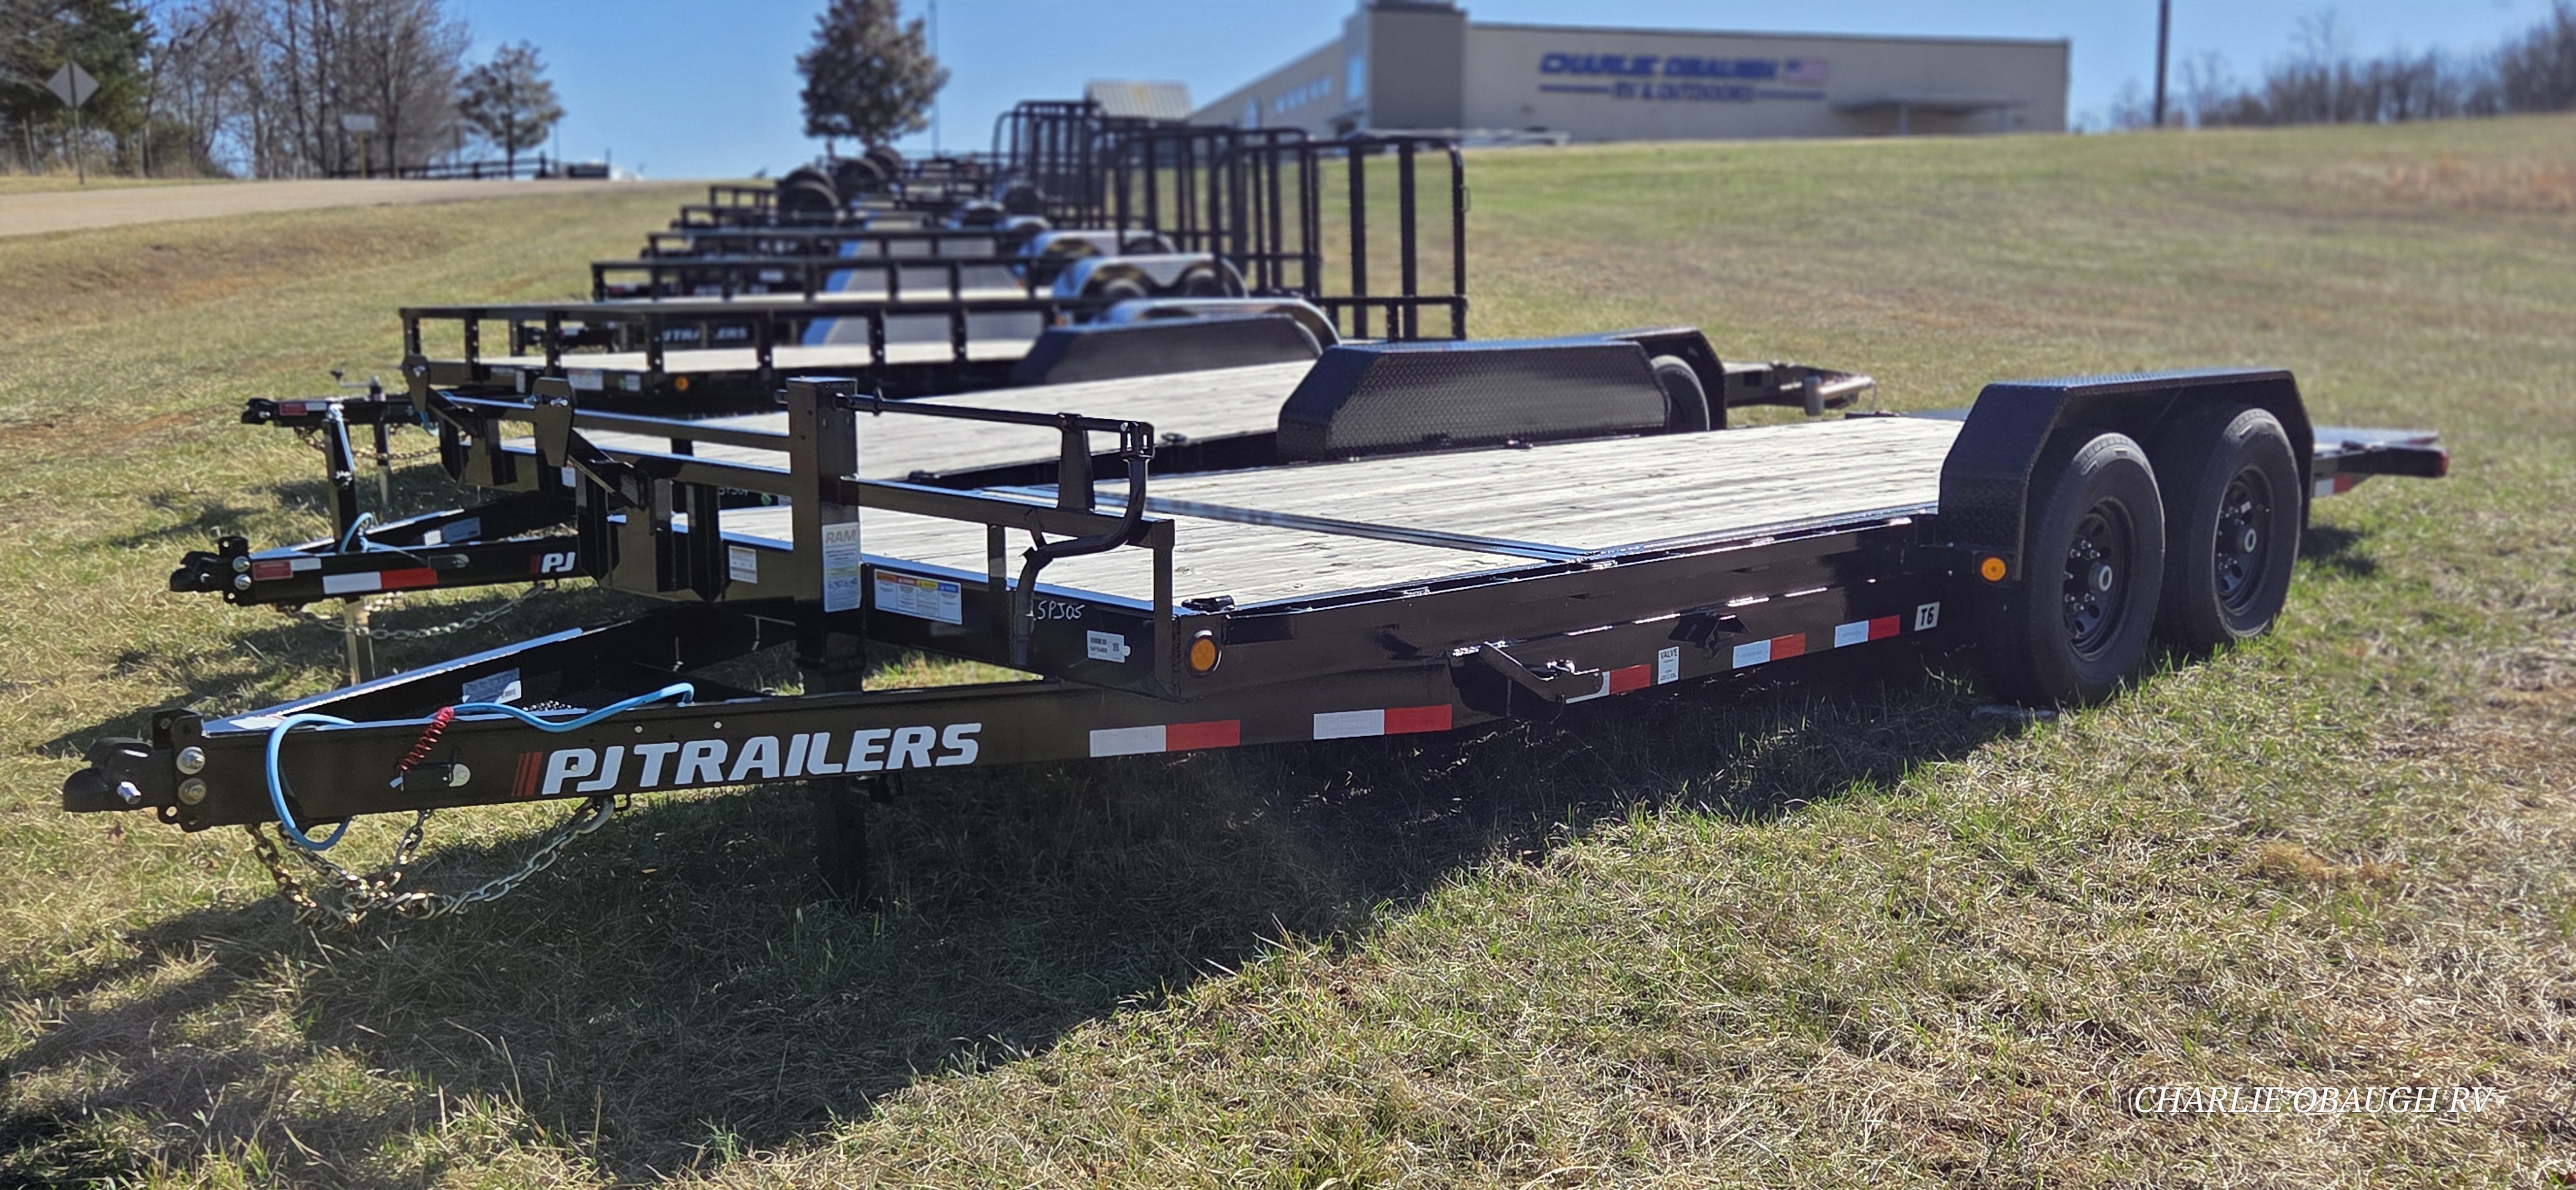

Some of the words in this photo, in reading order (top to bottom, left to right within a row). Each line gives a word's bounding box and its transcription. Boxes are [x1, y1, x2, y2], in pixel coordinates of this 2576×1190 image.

[542, 552, 576, 573] PJ
[1921, 607, 1935, 627] T6
[542, 746, 625, 795] PJ
[634, 723, 982, 787] TRAILERS
